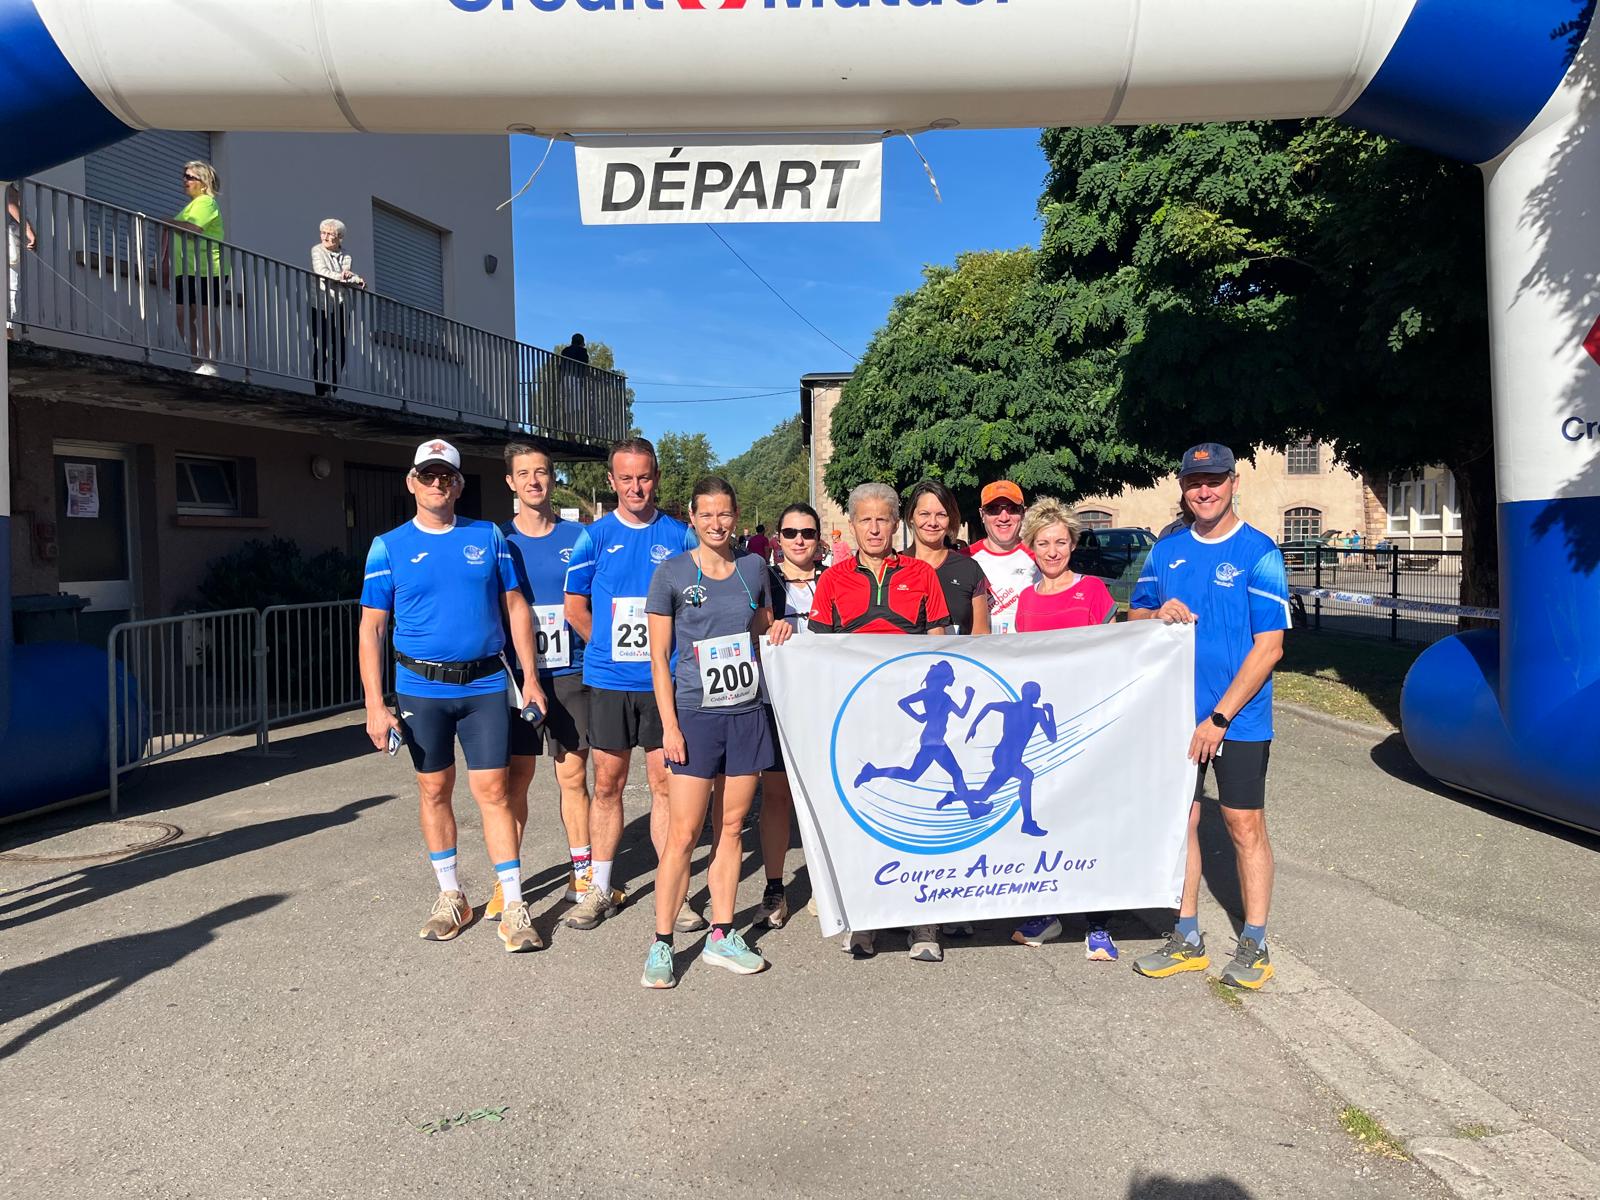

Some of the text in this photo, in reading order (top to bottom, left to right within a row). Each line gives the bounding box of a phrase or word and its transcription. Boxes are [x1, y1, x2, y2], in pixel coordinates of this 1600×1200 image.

[601, 147, 861, 213] DÉPART
[1561, 416, 1600, 442] Cr
[617, 623, 648, 648] 23
[706, 661, 754, 695] 200
[874, 850, 1098, 886] Courez Avec Nous
[914, 879, 1059, 904] SARREGUEMINES
